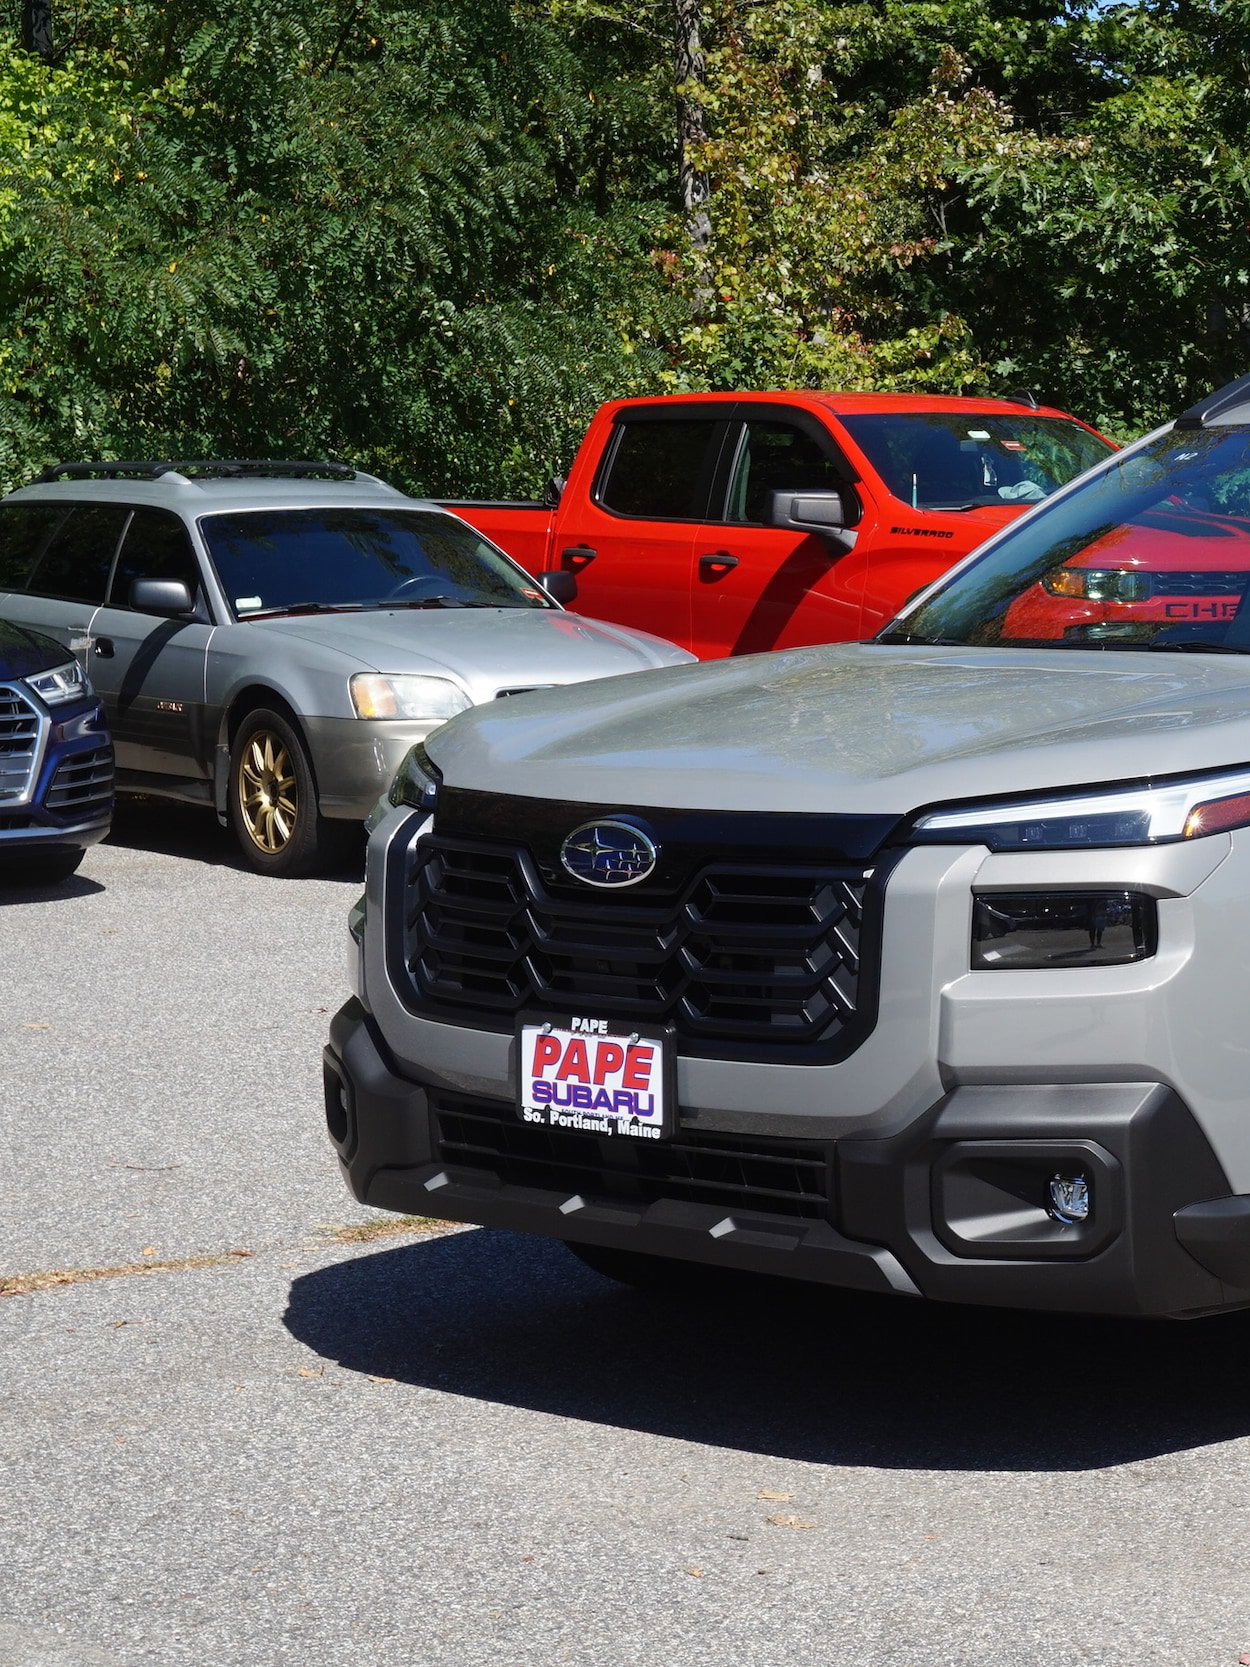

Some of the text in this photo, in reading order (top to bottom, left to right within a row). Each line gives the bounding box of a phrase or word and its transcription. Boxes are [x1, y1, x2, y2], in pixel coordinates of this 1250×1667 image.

[890, 527, 955, 539] SILVERADO
[571, 1017, 609, 1034] PAPE
[531, 1034, 655, 1091] PAPE
[531, 1080, 655, 1117] SUBARU
[523, 1107, 662, 1139] So. Portland, Maine
